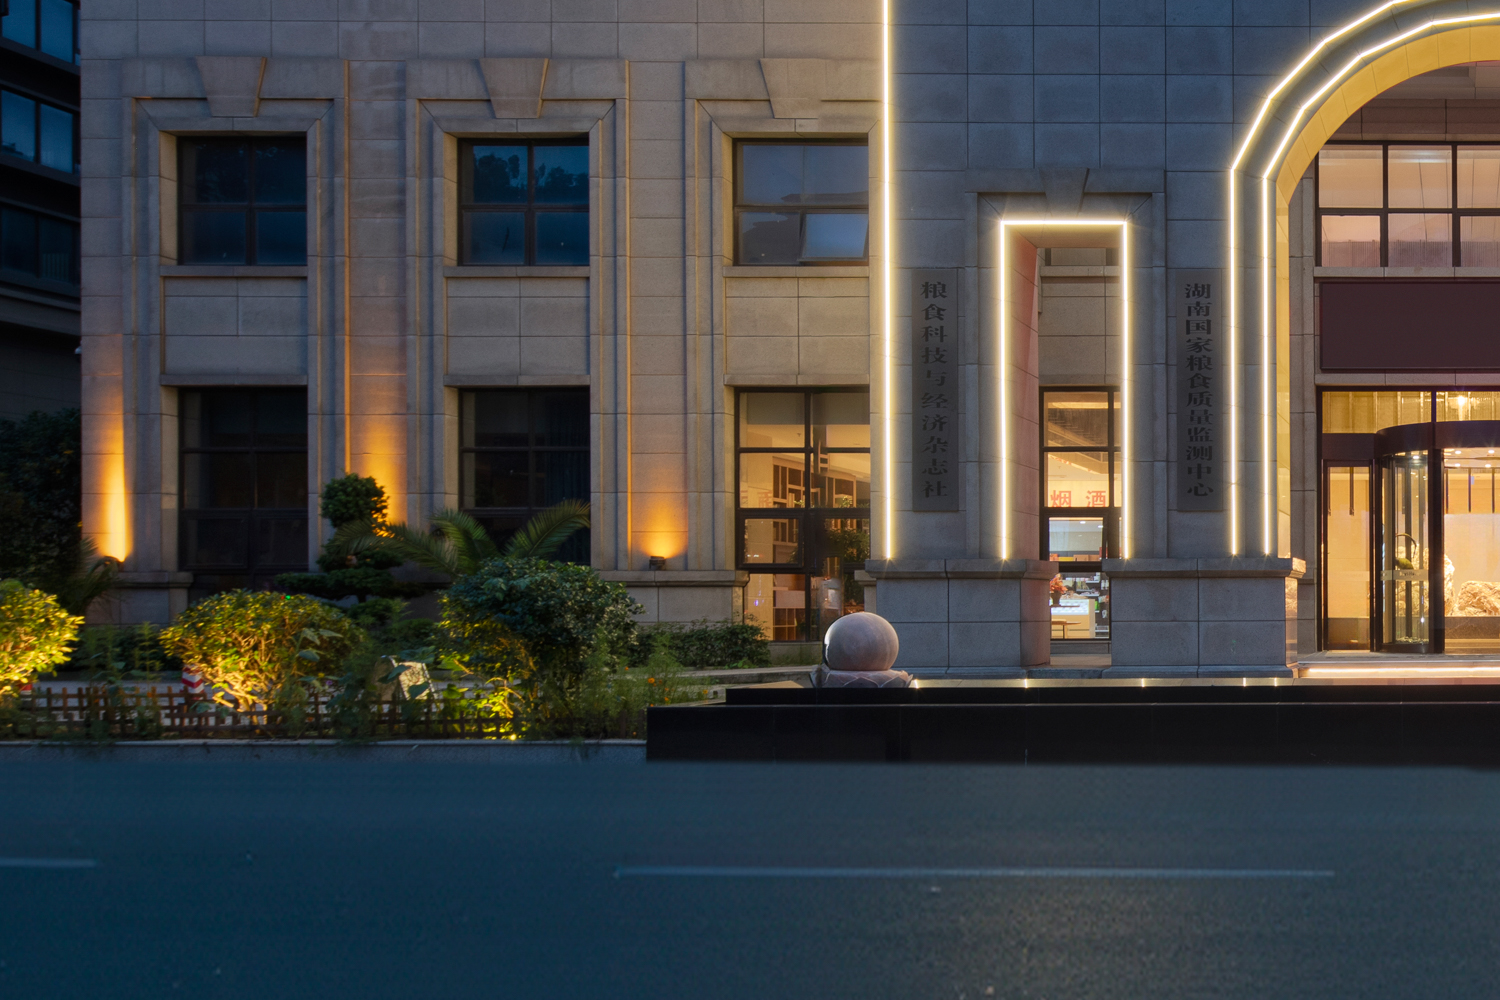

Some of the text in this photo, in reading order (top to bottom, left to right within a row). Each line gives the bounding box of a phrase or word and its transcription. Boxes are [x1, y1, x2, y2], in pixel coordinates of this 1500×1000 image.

[920, 281, 948, 498] 粮食科技与经济杂志社
[1184, 283, 1214, 497] 湖南国家粮食质量监测中心
